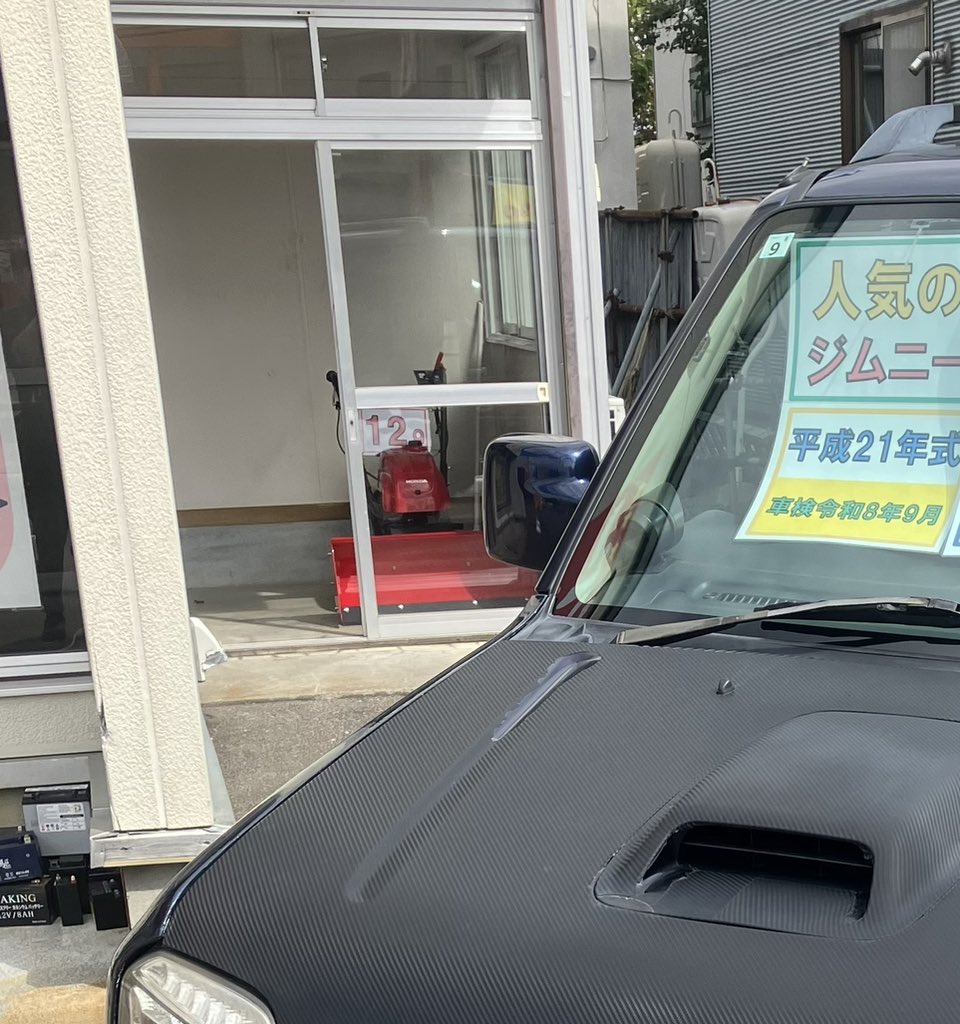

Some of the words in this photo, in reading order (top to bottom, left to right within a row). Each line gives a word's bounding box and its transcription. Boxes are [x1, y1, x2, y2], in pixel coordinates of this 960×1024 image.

[768, 242, 780, 256] 9
[766, 496, 944, 526] 車検令和8年9月
